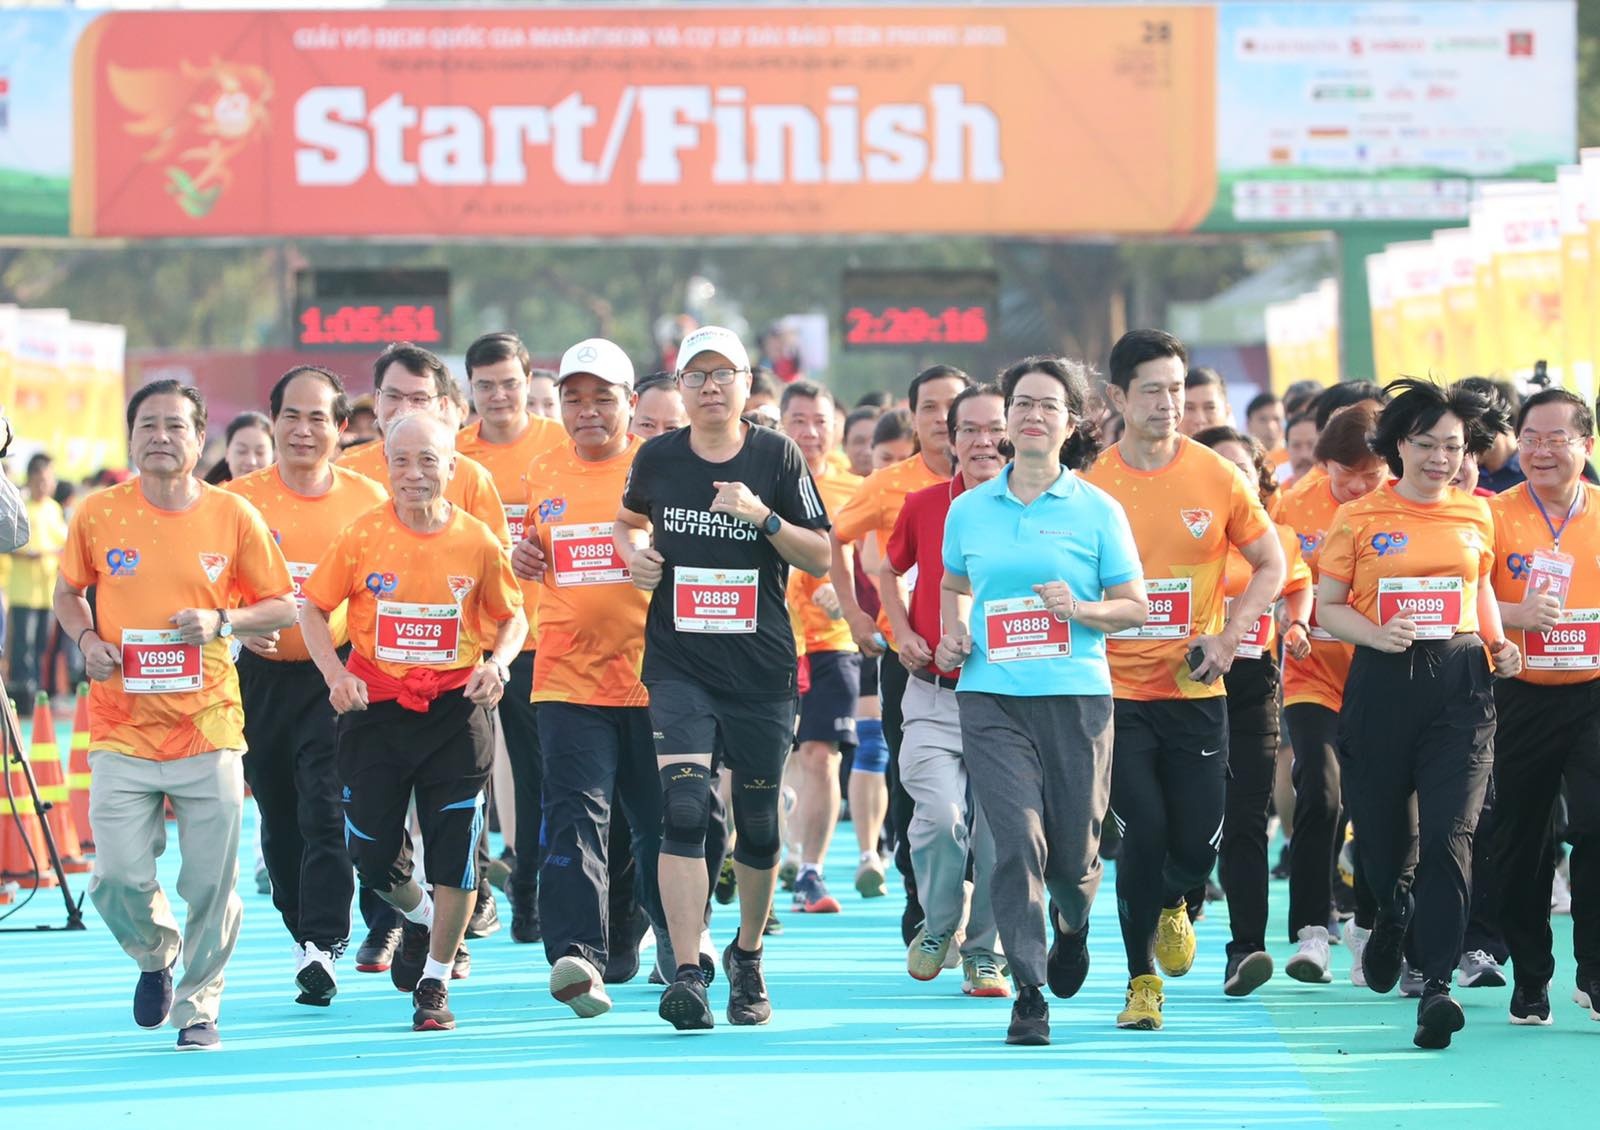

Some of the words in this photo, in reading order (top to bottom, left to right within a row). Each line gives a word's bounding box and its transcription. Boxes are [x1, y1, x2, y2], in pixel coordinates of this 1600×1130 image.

[294, 84, 1004, 186] Start/Finish
[664, 520, 758, 542] NUTRITION
[568, 543, 614, 559] V9889
[692, 590, 740, 605] V8889
[1396, 598, 1445, 612] V9899
[394, 622, 442, 638] V5678
[1002, 617, 1050, 634] V8888
[1541, 629, 1587, 644] V8668
[137, 650, 186, 665] V6996
